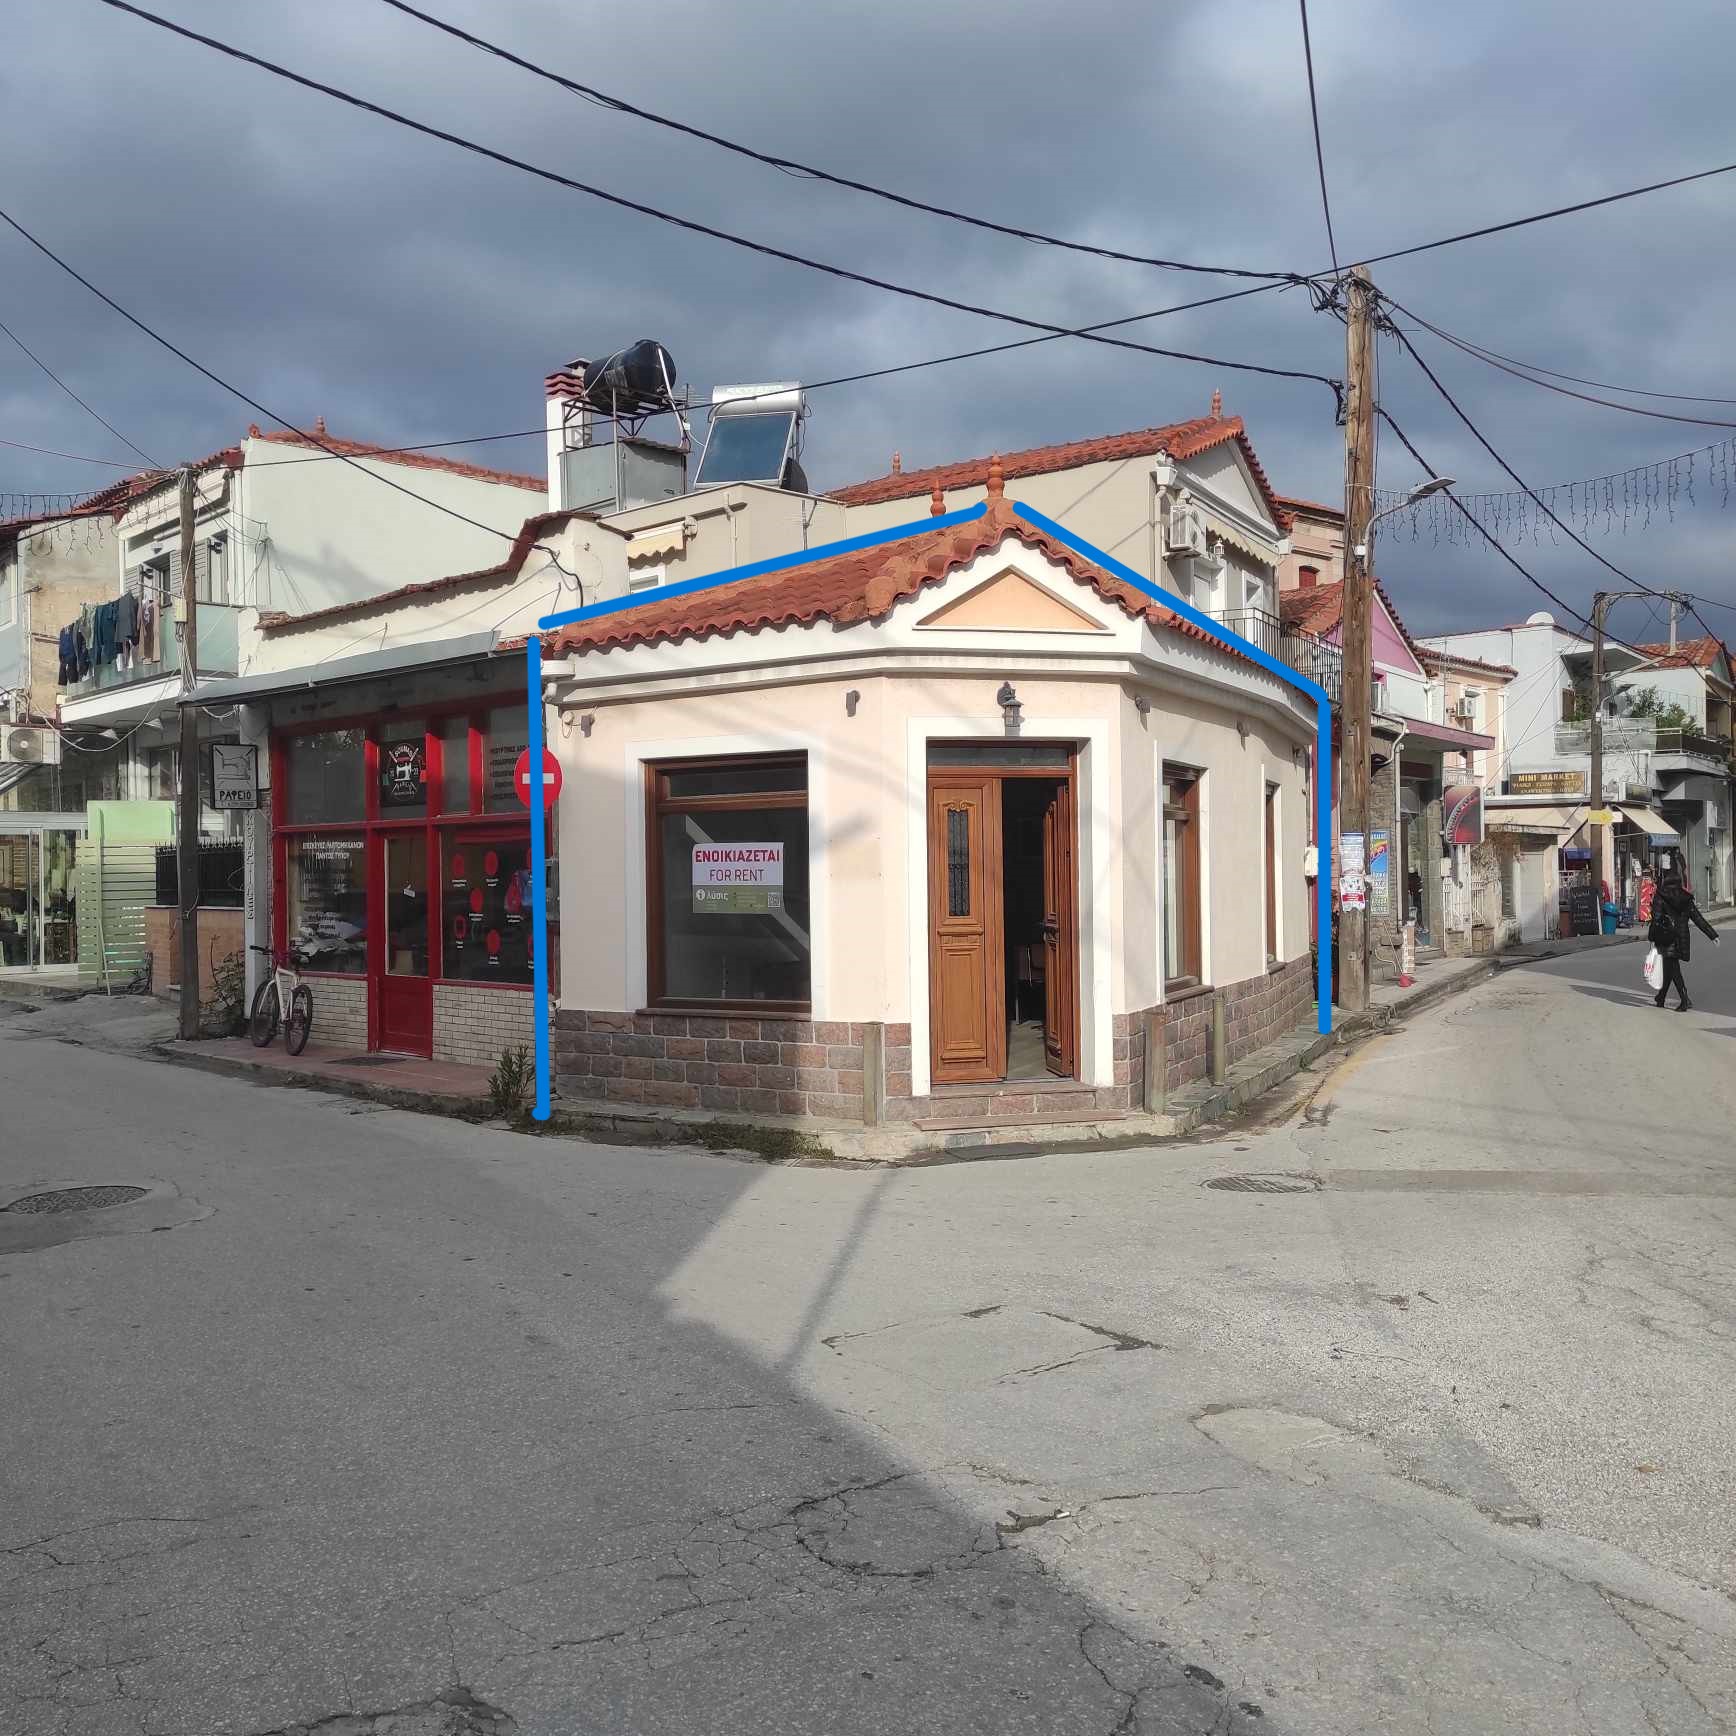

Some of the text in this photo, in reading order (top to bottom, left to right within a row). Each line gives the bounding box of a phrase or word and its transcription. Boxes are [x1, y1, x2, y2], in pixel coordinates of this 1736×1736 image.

[1518, 773, 1576, 782] MINI MARKET
[219, 790, 252, 800] ΡΑΦΕΙΟ
[695, 850, 780, 862] ΕΝΟΙΚΙΑΖΕΤΑΙ
[709, 868, 765, 881] FOR RENT
